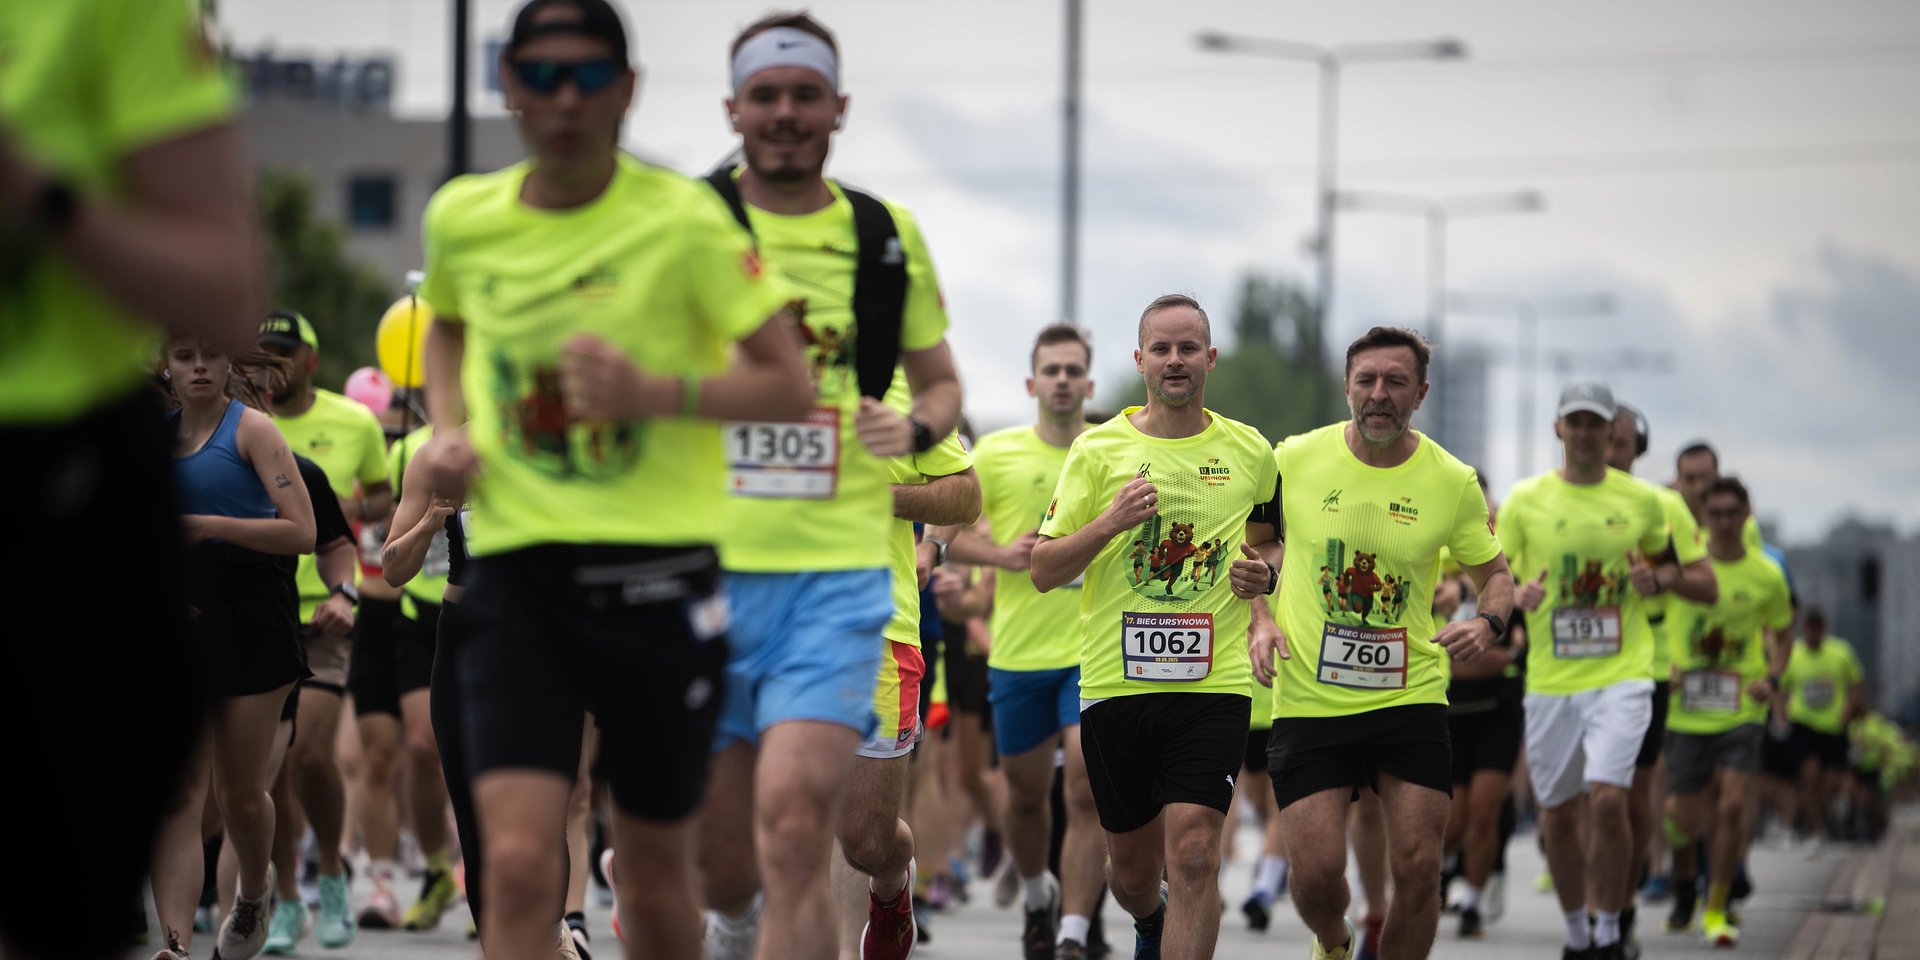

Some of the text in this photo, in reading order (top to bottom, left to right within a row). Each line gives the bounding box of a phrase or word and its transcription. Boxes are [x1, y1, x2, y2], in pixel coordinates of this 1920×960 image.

[736, 427, 825, 461] 1305
[1136, 617, 1157, 625] BIEG
[1158, 618, 1210, 626] URSYNOWA
[1568, 617, 1605, 640] 191
[1134, 631, 1201, 655] 1062
[1338, 628, 1358, 637] BIEG
[1360, 632, 1404, 641] URSYNOWA
[1342, 641, 1391, 666] 760
